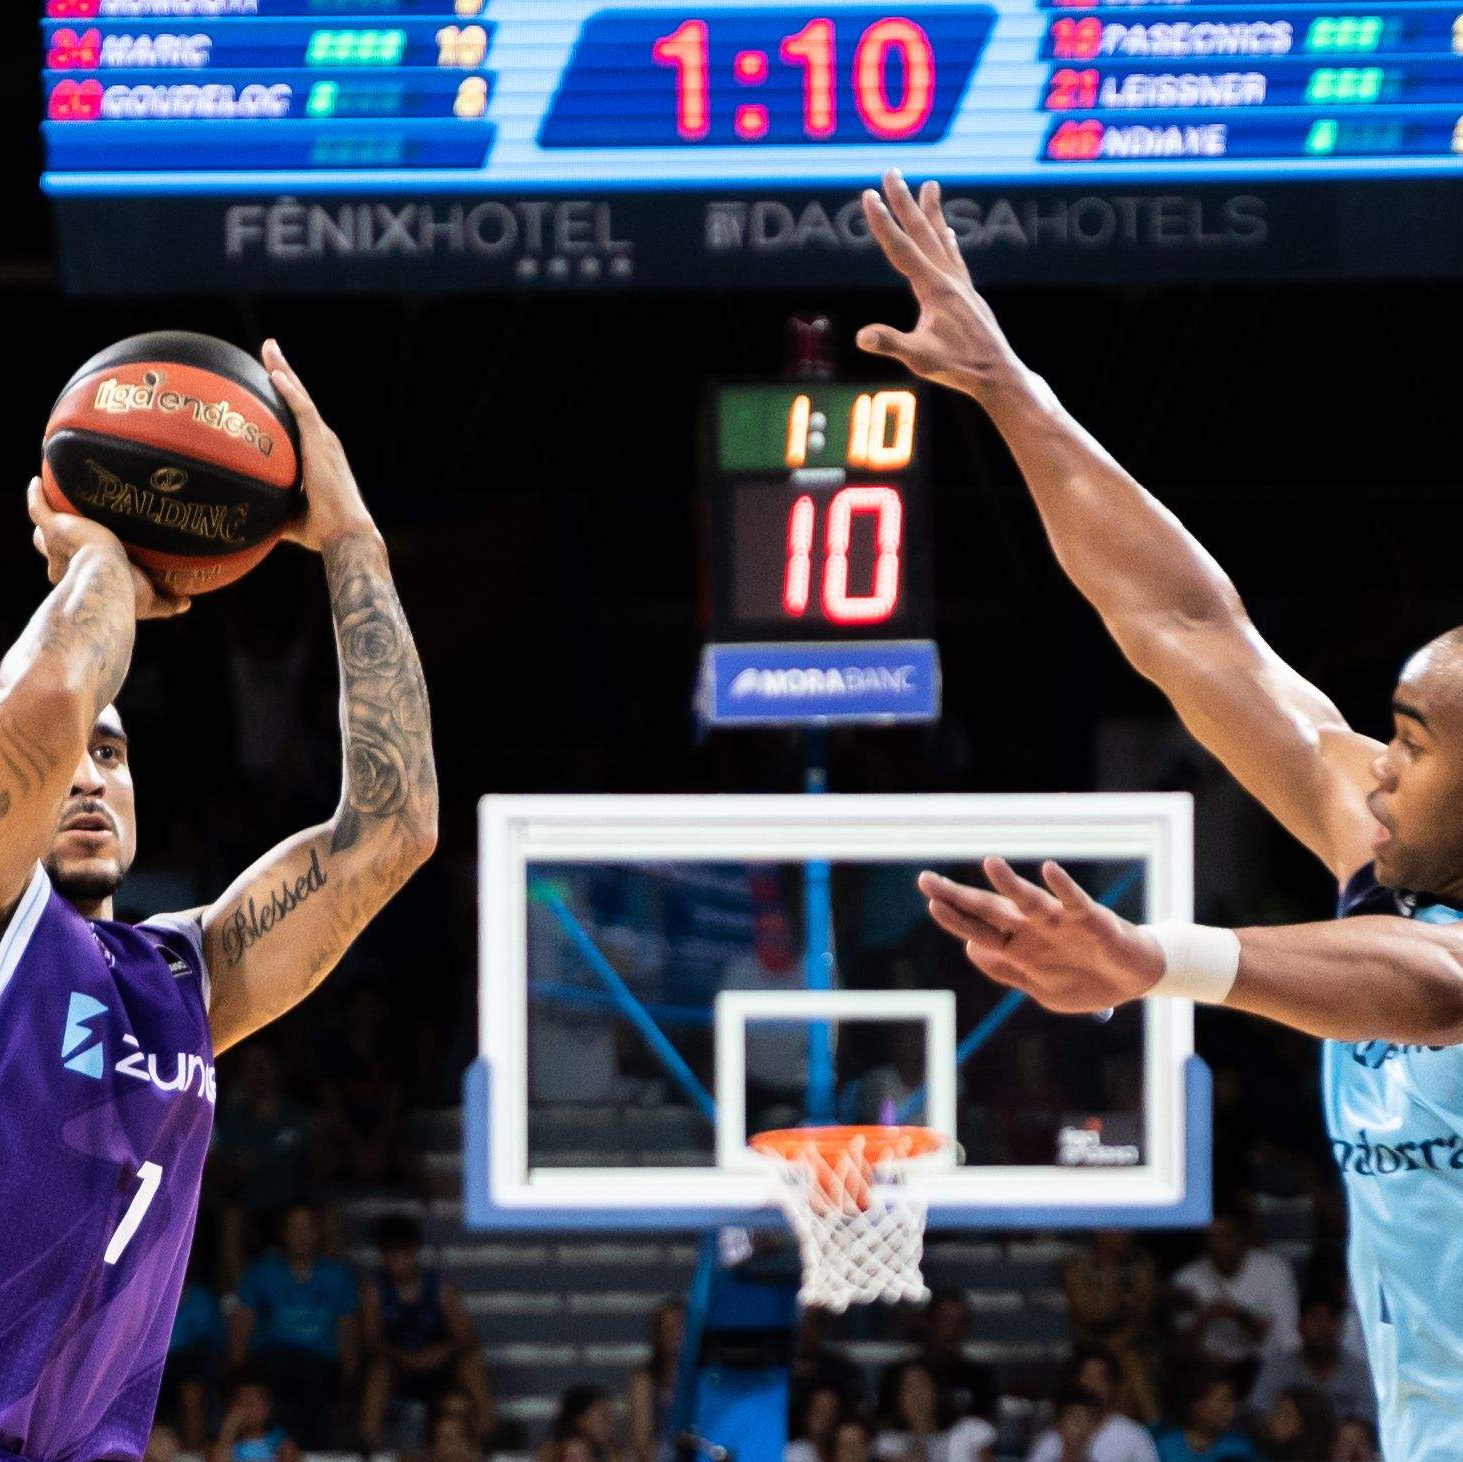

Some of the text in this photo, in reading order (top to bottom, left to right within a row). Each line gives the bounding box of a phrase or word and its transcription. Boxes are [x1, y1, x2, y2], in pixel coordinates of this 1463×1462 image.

[652, 18, 936, 141] 1:10
[1099, 71, 1266, 107] LEISSNER
[782, 486, 903, 628] 10
[222, 848, 328, 966] Blessed
